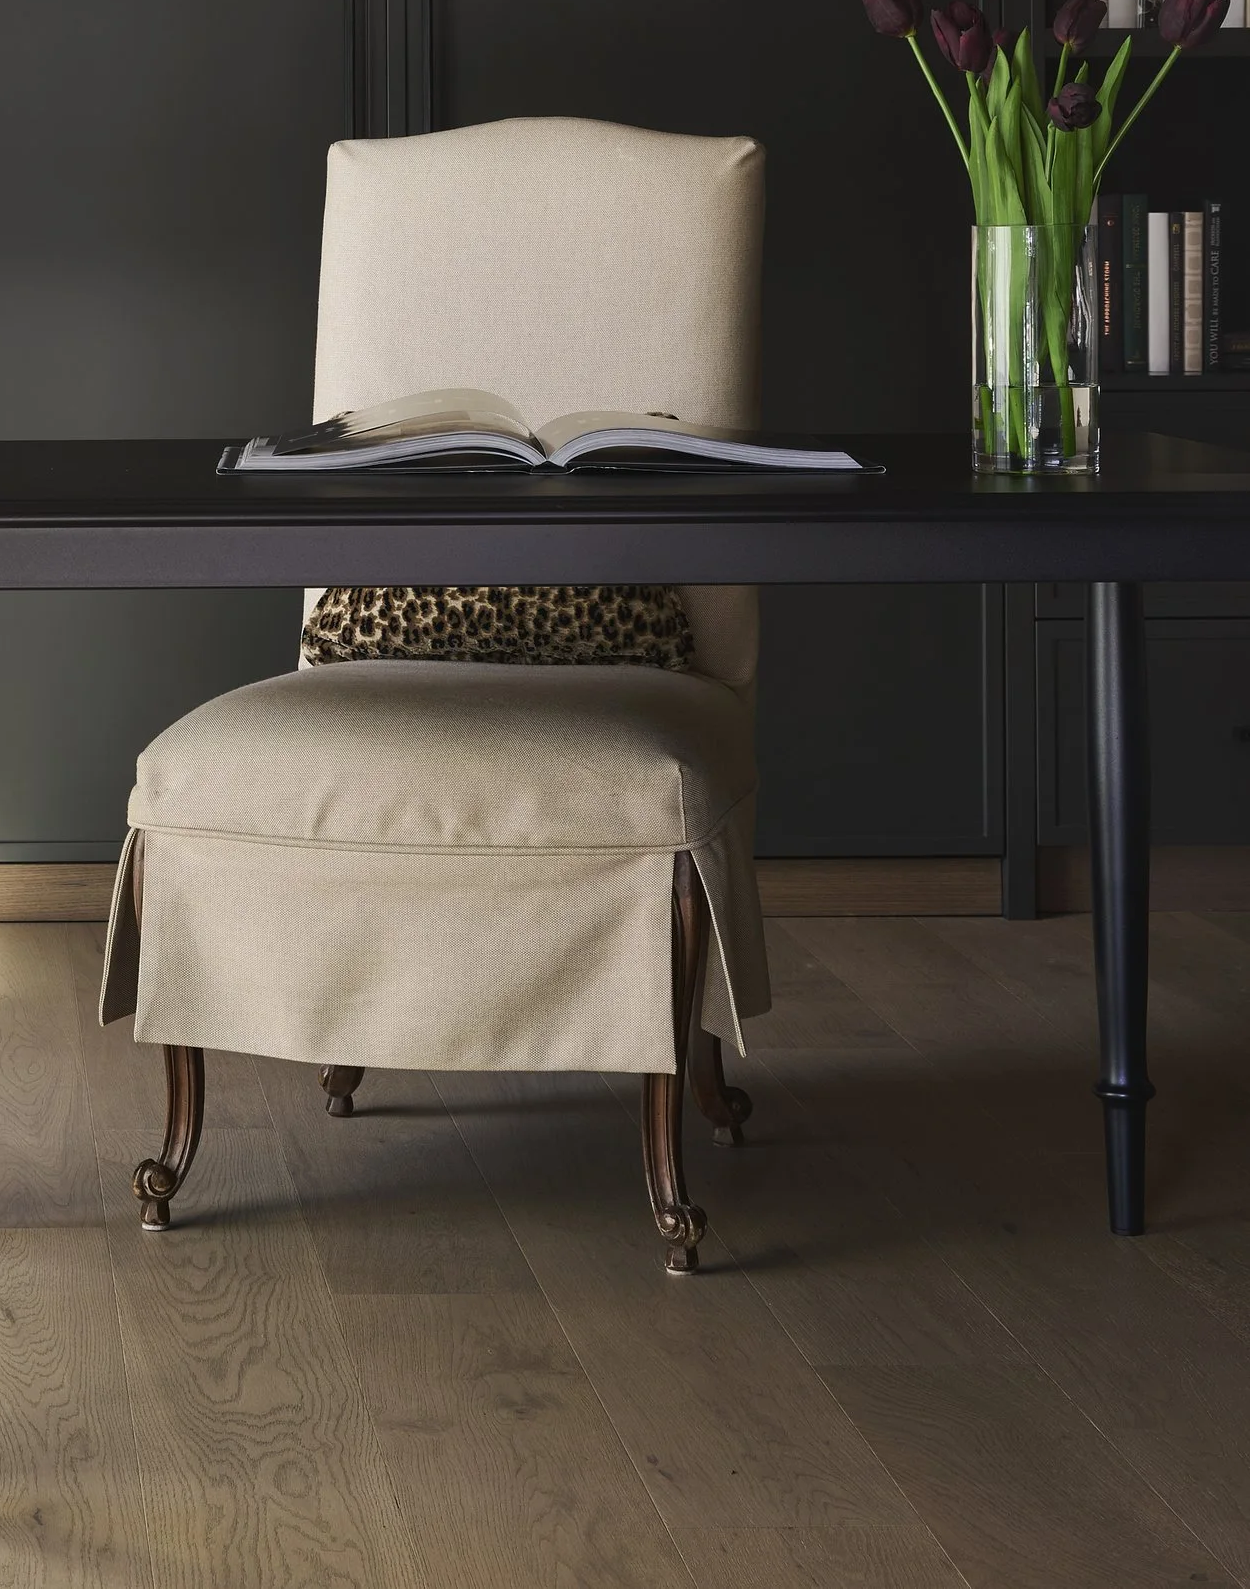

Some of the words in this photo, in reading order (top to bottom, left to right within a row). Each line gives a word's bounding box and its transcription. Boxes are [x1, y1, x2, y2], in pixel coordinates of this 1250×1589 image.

[1211, 251, 1219, 275] CARE
[1213, 276, 1219, 285] TO
[1213, 307, 1218, 315] BE
[1210, 318, 1218, 342] WILL
[1210, 345, 1218, 365] YOU
